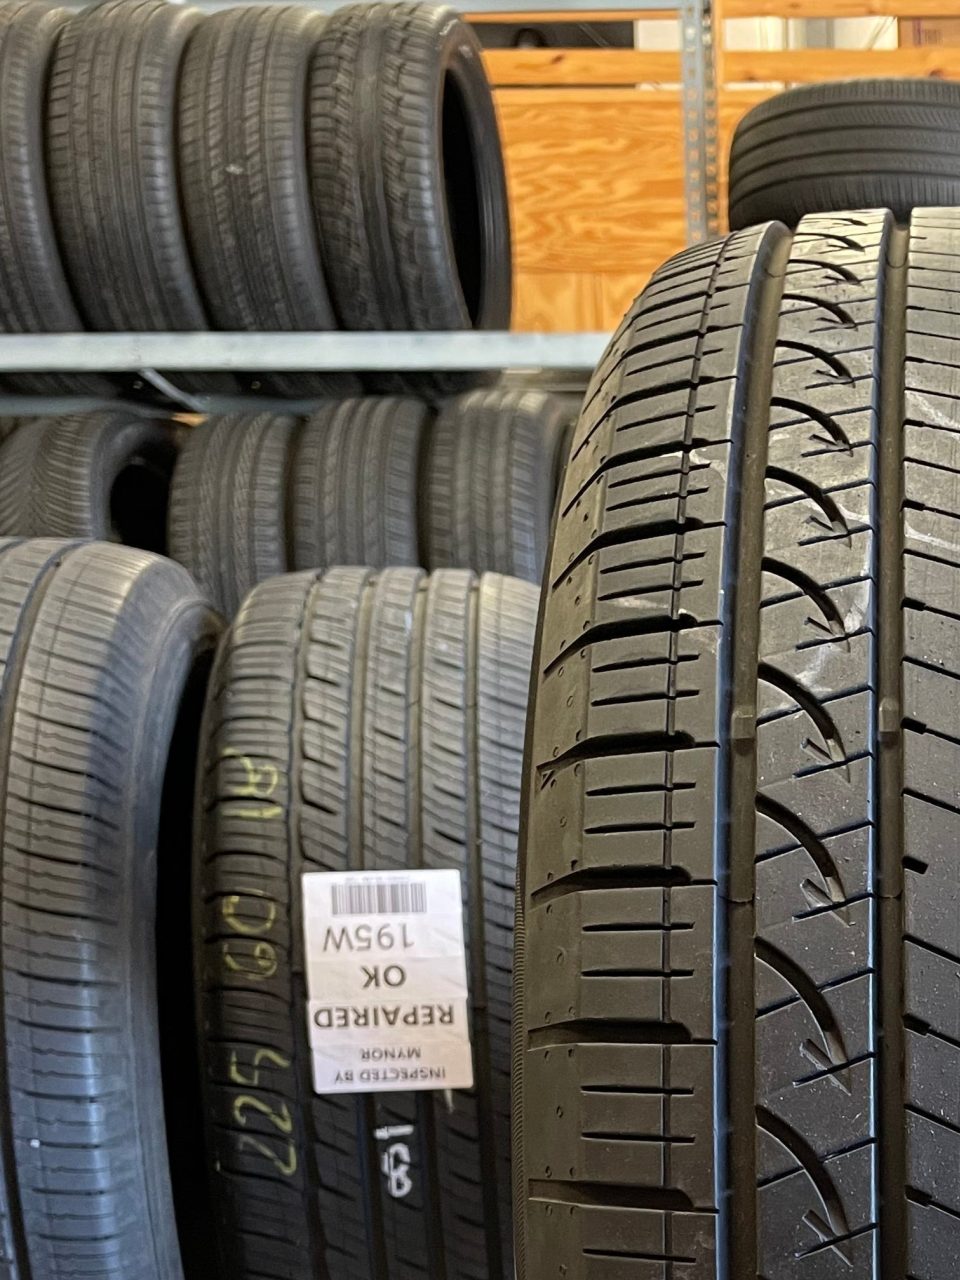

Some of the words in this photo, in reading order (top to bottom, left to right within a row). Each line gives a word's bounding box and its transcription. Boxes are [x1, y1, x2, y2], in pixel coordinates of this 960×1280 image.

[221, 887, 279, 981] 60
[323, 923, 415, 952] 195W
[360, 964, 407, 989] OK
[314, 1004, 455, 1029] REPAIRED
[361, 1047, 422, 1061] MYNOR
[335, 1069, 354, 1084] BY
[360, 1066, 446, 1082] INSPECTED
[230, 1047, 299, 1177] 225
